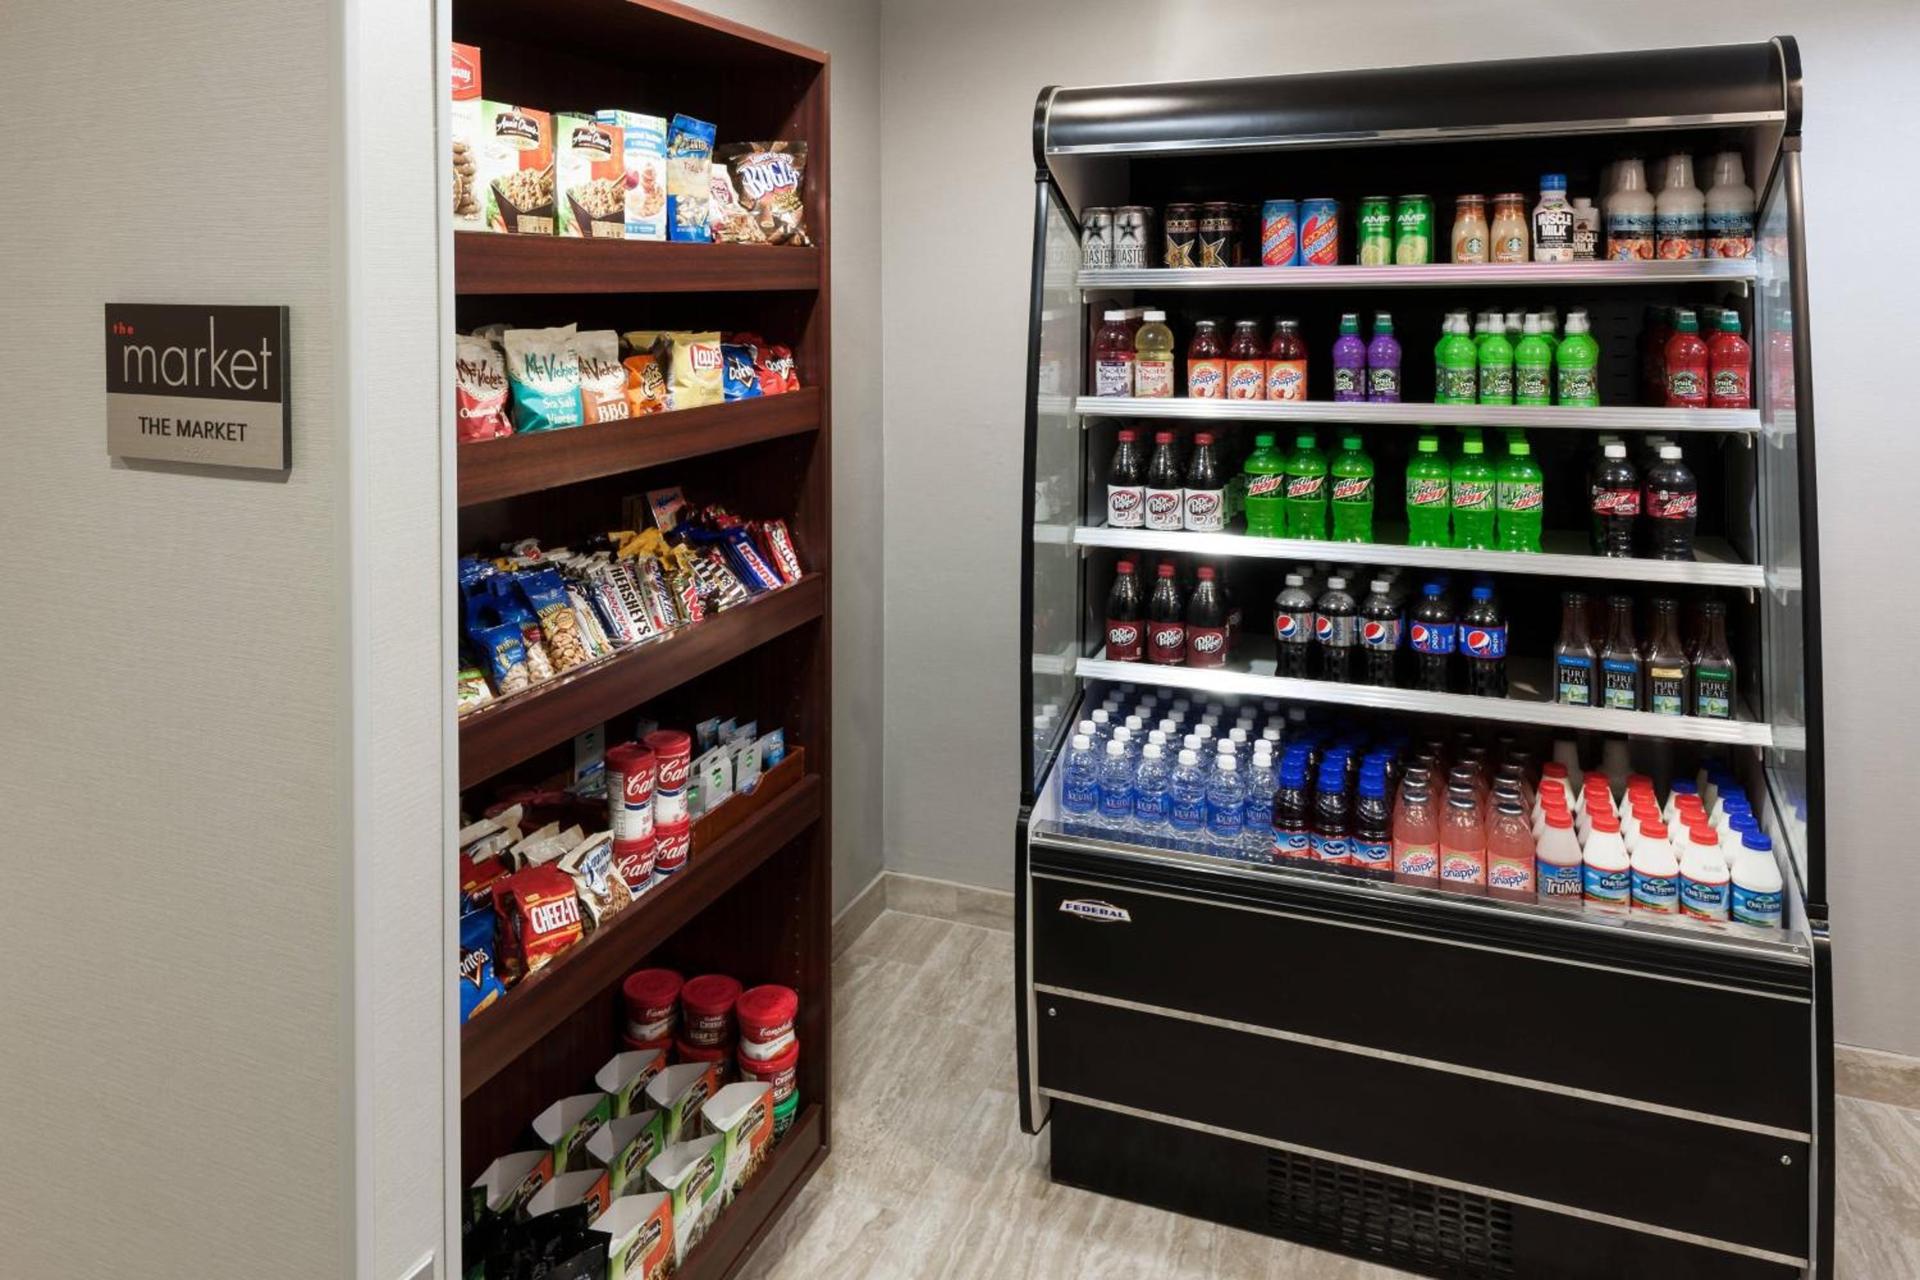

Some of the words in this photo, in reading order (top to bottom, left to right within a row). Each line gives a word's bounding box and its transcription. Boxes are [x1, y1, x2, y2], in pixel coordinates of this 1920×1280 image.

[1362, 215, 1391, 224] AMP
[1397, 213, 1427, 224] AMP
[1538, 212, 1572, 225] MUSCLE
[1541, 224, 1566, 237] MILK
[1573, 232, 1598, 242] USCLE
[113, 320, 135, 336] the
[123, 315, 273, 391] market
[1191, 372, 1221, 386] Snapple
[1231, 372, 1263, 386] Snapple
[1268, 372, 1302, 386] Snapple
[597, 401, 629, 424] BBQ
[138, 416, 171, 436] THE
[176, 418, 248, 443] MARKET
[1560, 669, 1586, 677] PURE
[1606, 673, 1633, 682] PURE
[1561, 676, 1586, 685] LEAF
[1607, 680, 1632, 689] LEAF
[1654, 681, 1680, 690] PURE
[1700, 682, 1728, 690] PURE
[1654, 688, 1679, 696] LEAF
[1700, 689, 1726, 698] LEAF
[1443, 865, 1481, 879] Snapple
[1490, 872, 1529, 886] Snapple
[1643, 882, 1656, 892] Oak
[1685, 886, 1700, 897] Oak
[1065, 903, 1125, 918] FEDERAL
